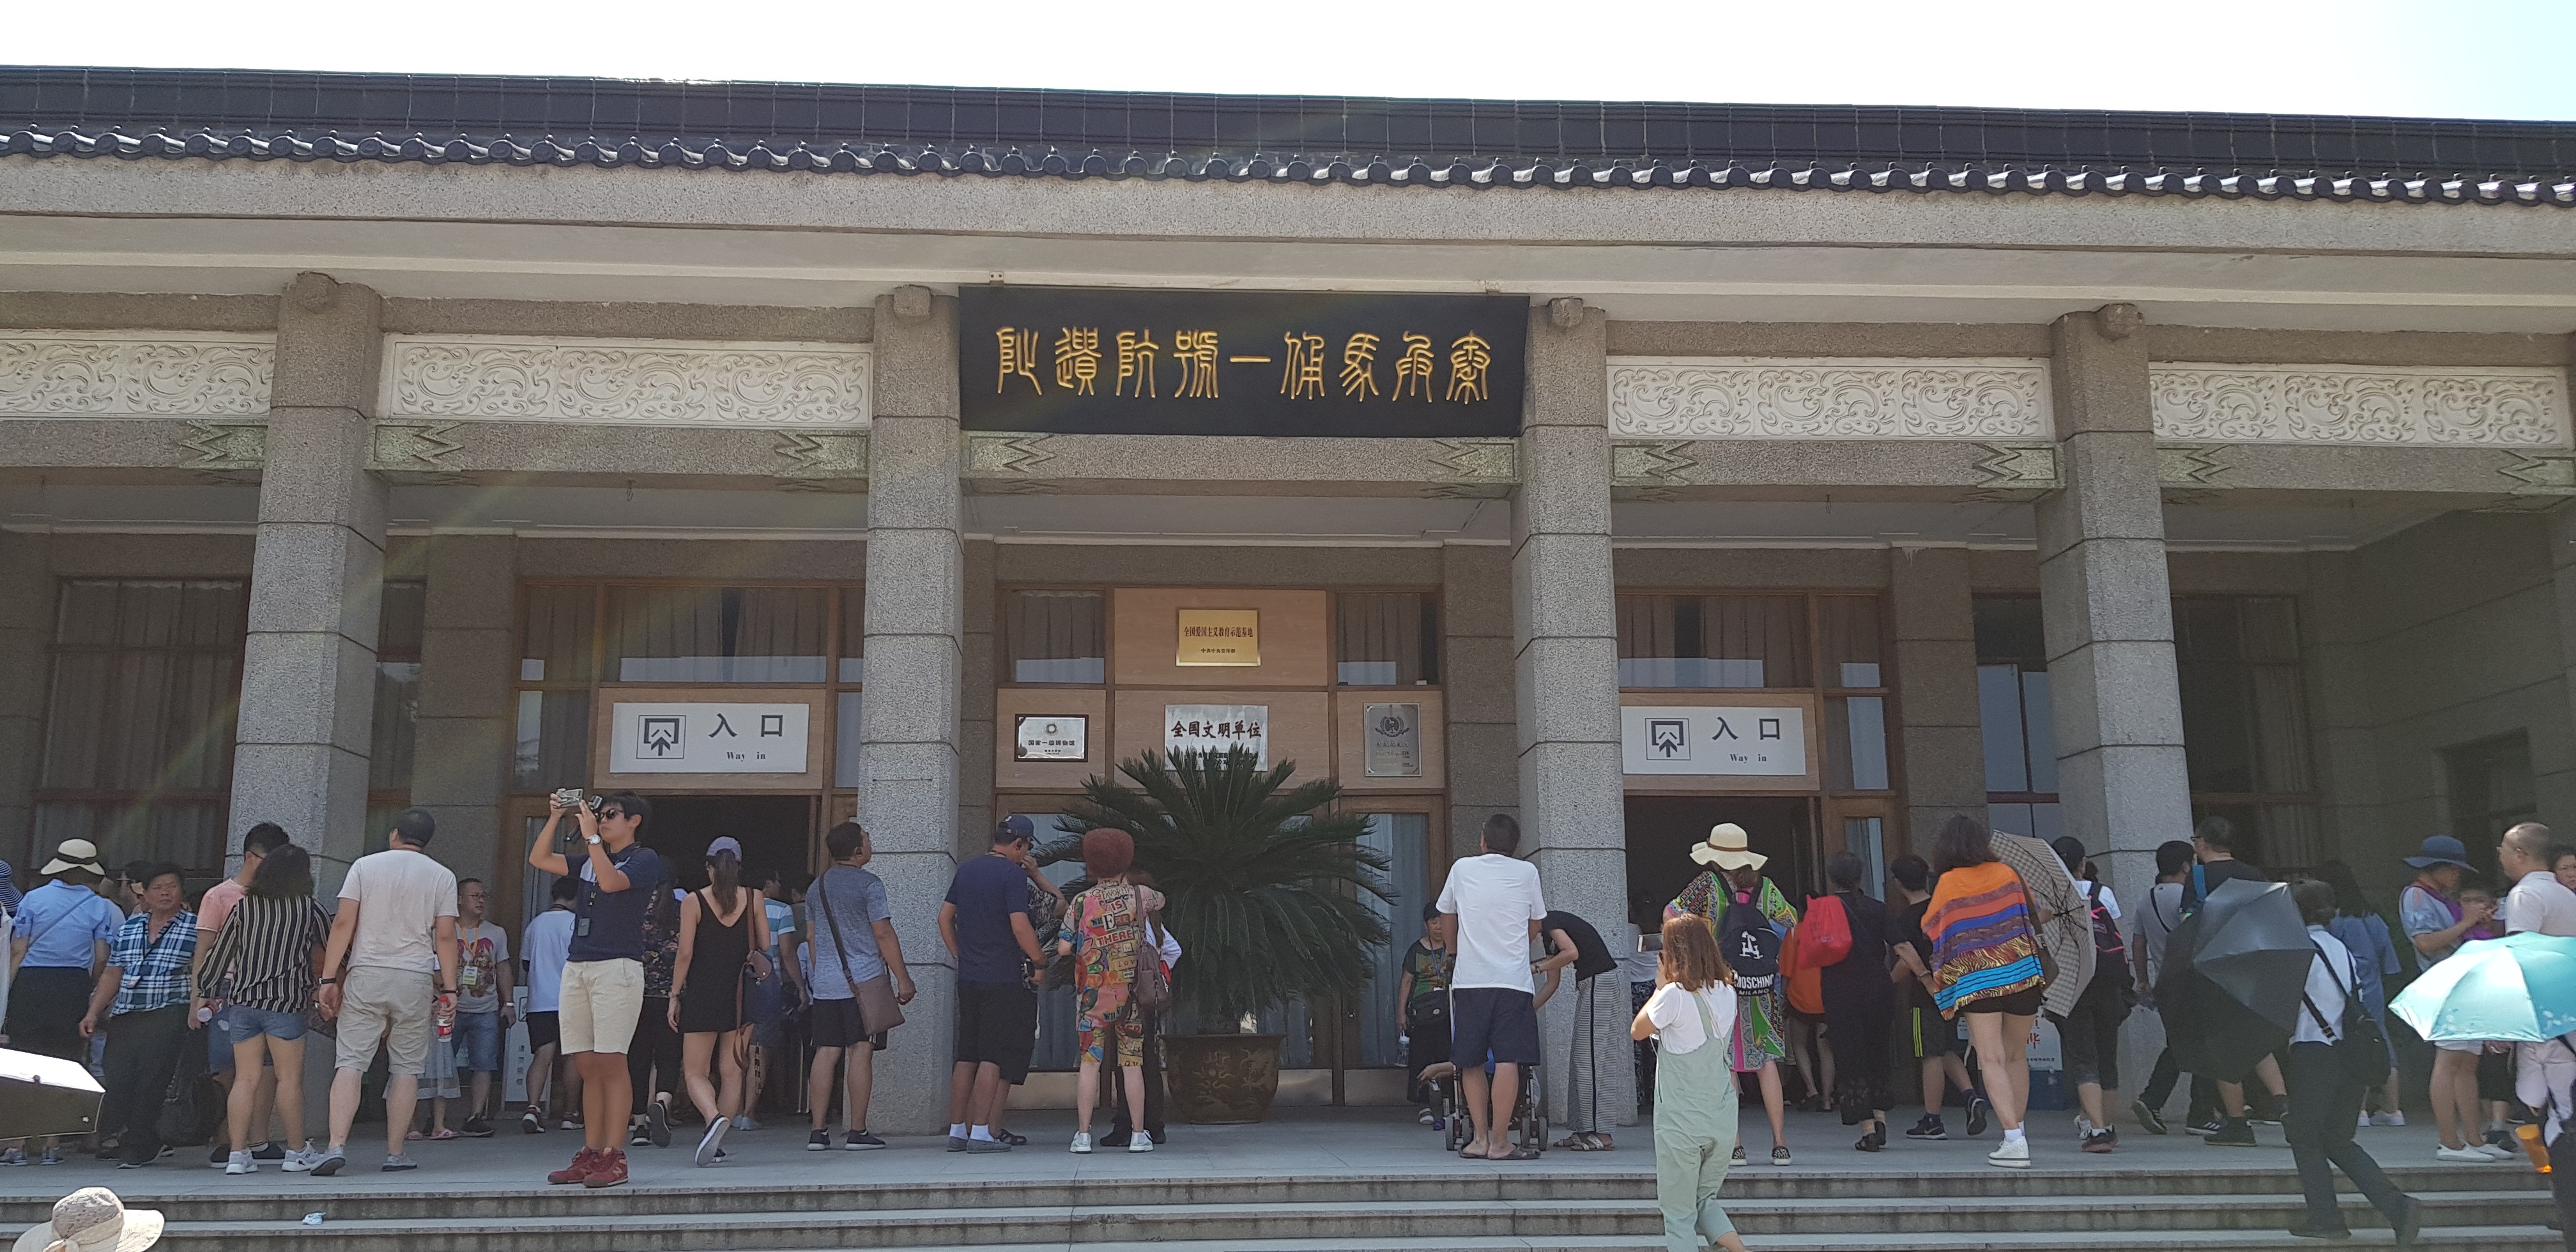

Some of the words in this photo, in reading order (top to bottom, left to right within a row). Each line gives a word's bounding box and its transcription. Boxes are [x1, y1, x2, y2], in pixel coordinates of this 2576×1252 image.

[1184, 626, 1254, 637] 全国爱国主义教育示范基地
[708, 712, 784, 738] 入口
[1170, 720, 1262, 741] 全国文明单位
[1711, 716, 1781, 740] 入口
[726, 751, 747, 762] Way
[756, 751, 766, 760] in
[1729, 753, 1749, 764] Way
[1758, 753, 1767, 762] in
[1096, 929, 1133, 946] THERE
